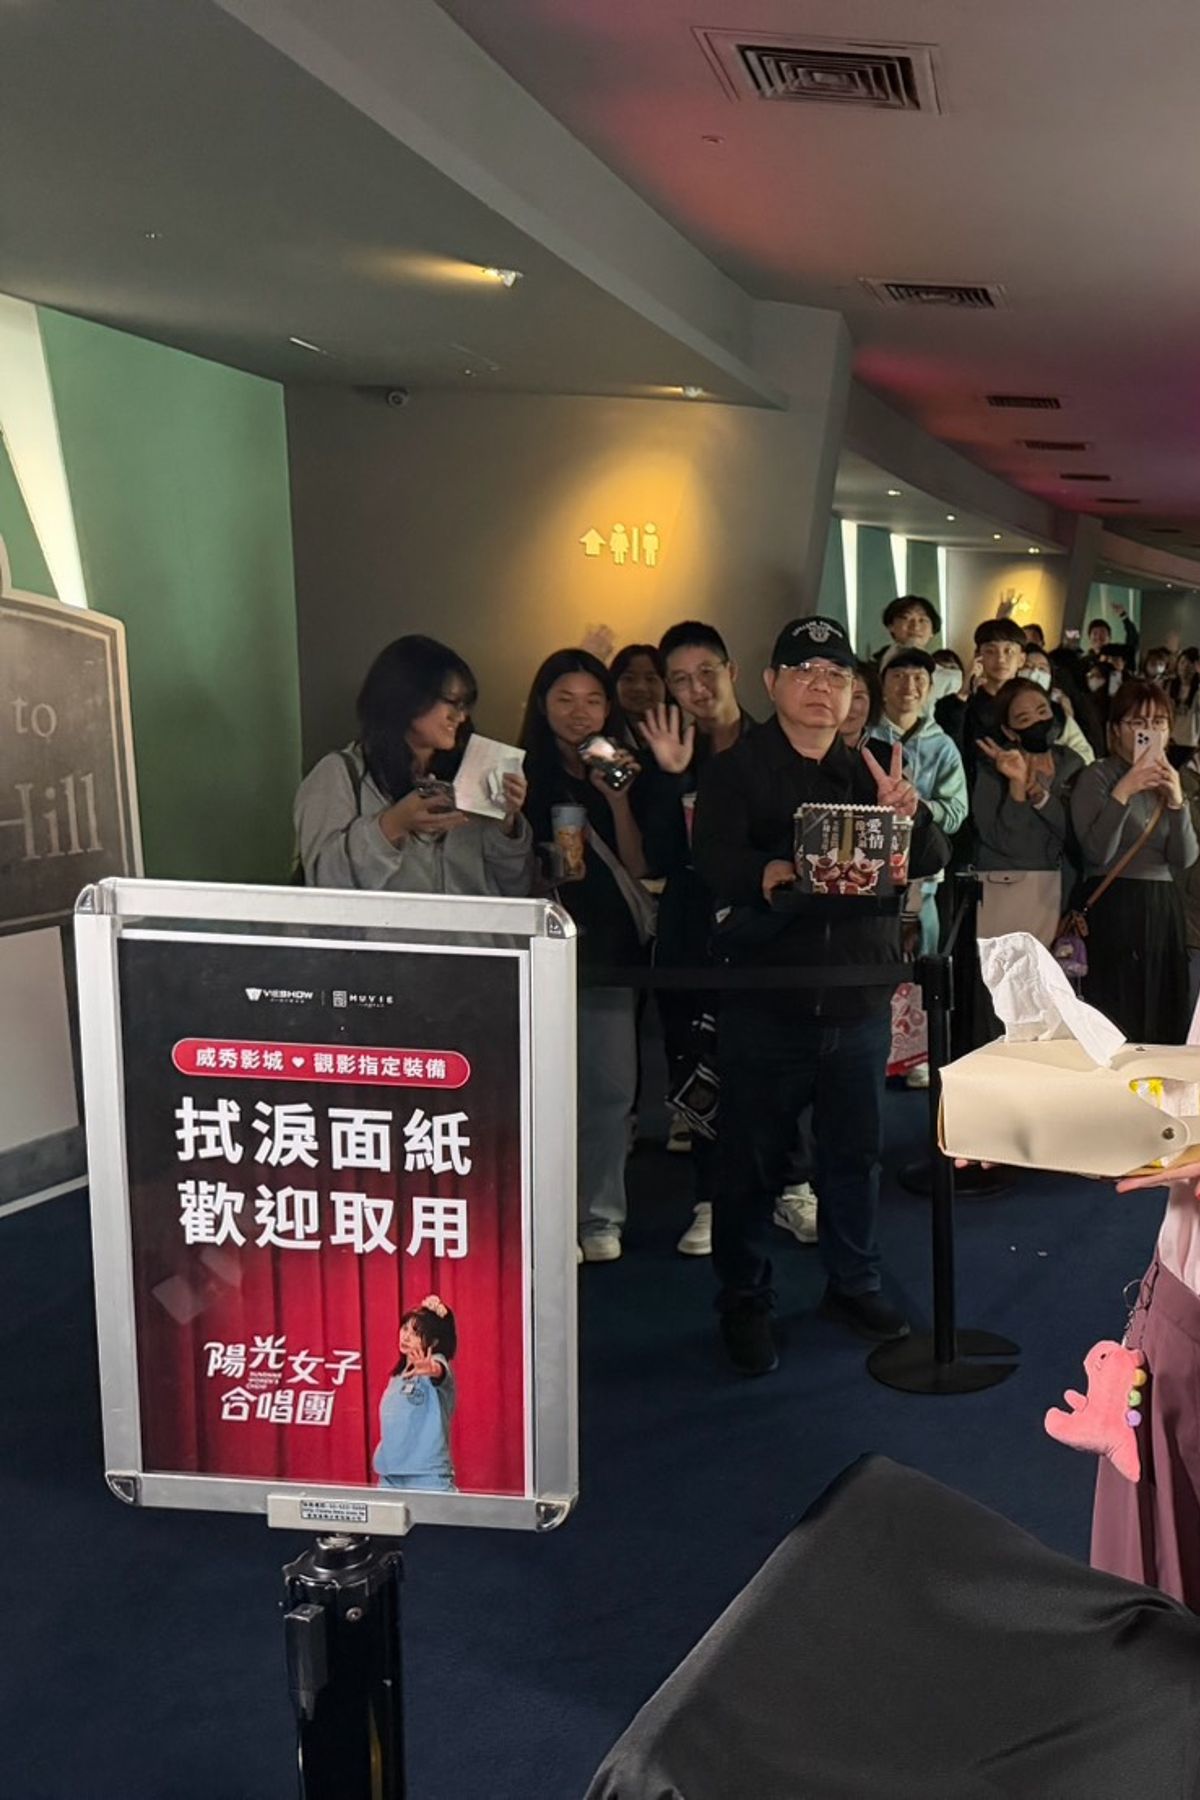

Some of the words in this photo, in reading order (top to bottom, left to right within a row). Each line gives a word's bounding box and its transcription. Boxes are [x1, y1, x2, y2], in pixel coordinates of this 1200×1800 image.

[12, 697, 57, 738] to
[195, 1047, 284, 1071] 威秀影城
[313, 1053, 447, 1079] 觀影指定裝備
[174, 1096, 472, 1176] 拭淚面紙
[177, 1180, 469, 1259] 歡迎取用
[203, 1334, 362, 1386] 陽光女子
[220, 1386, 336, 1426] 合唱團
